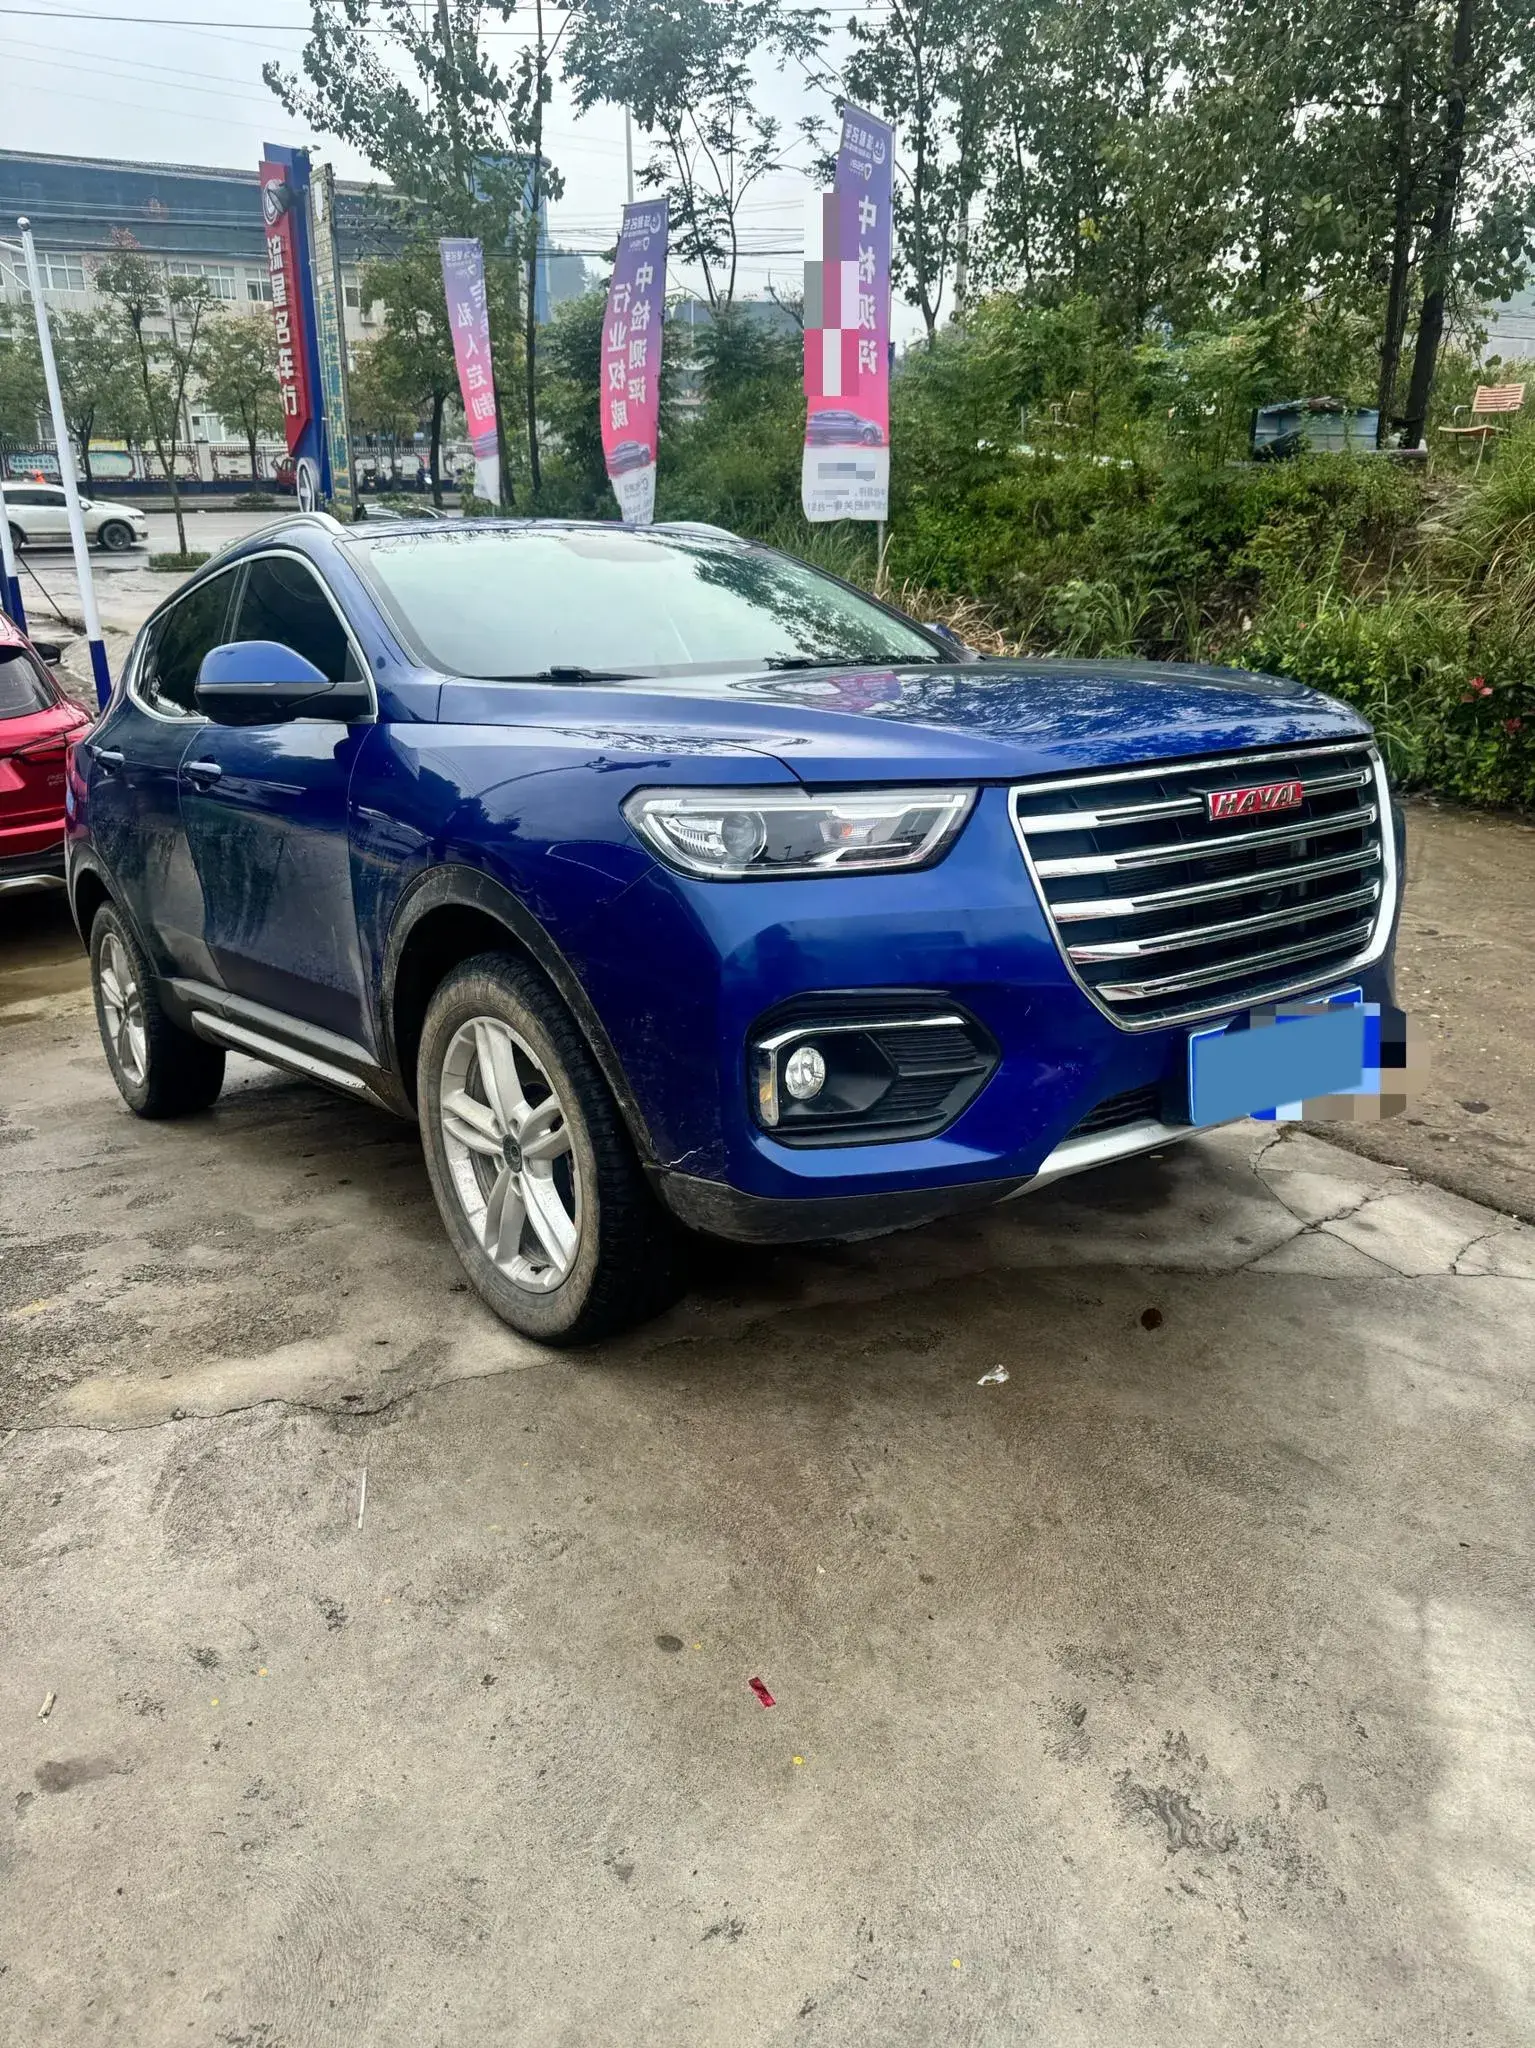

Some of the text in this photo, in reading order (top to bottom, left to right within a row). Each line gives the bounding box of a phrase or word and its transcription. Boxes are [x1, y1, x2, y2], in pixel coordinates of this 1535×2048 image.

[267, 234, 298, 416] 流星名车行
[1215, 784, 1302, 816] HAVAL
